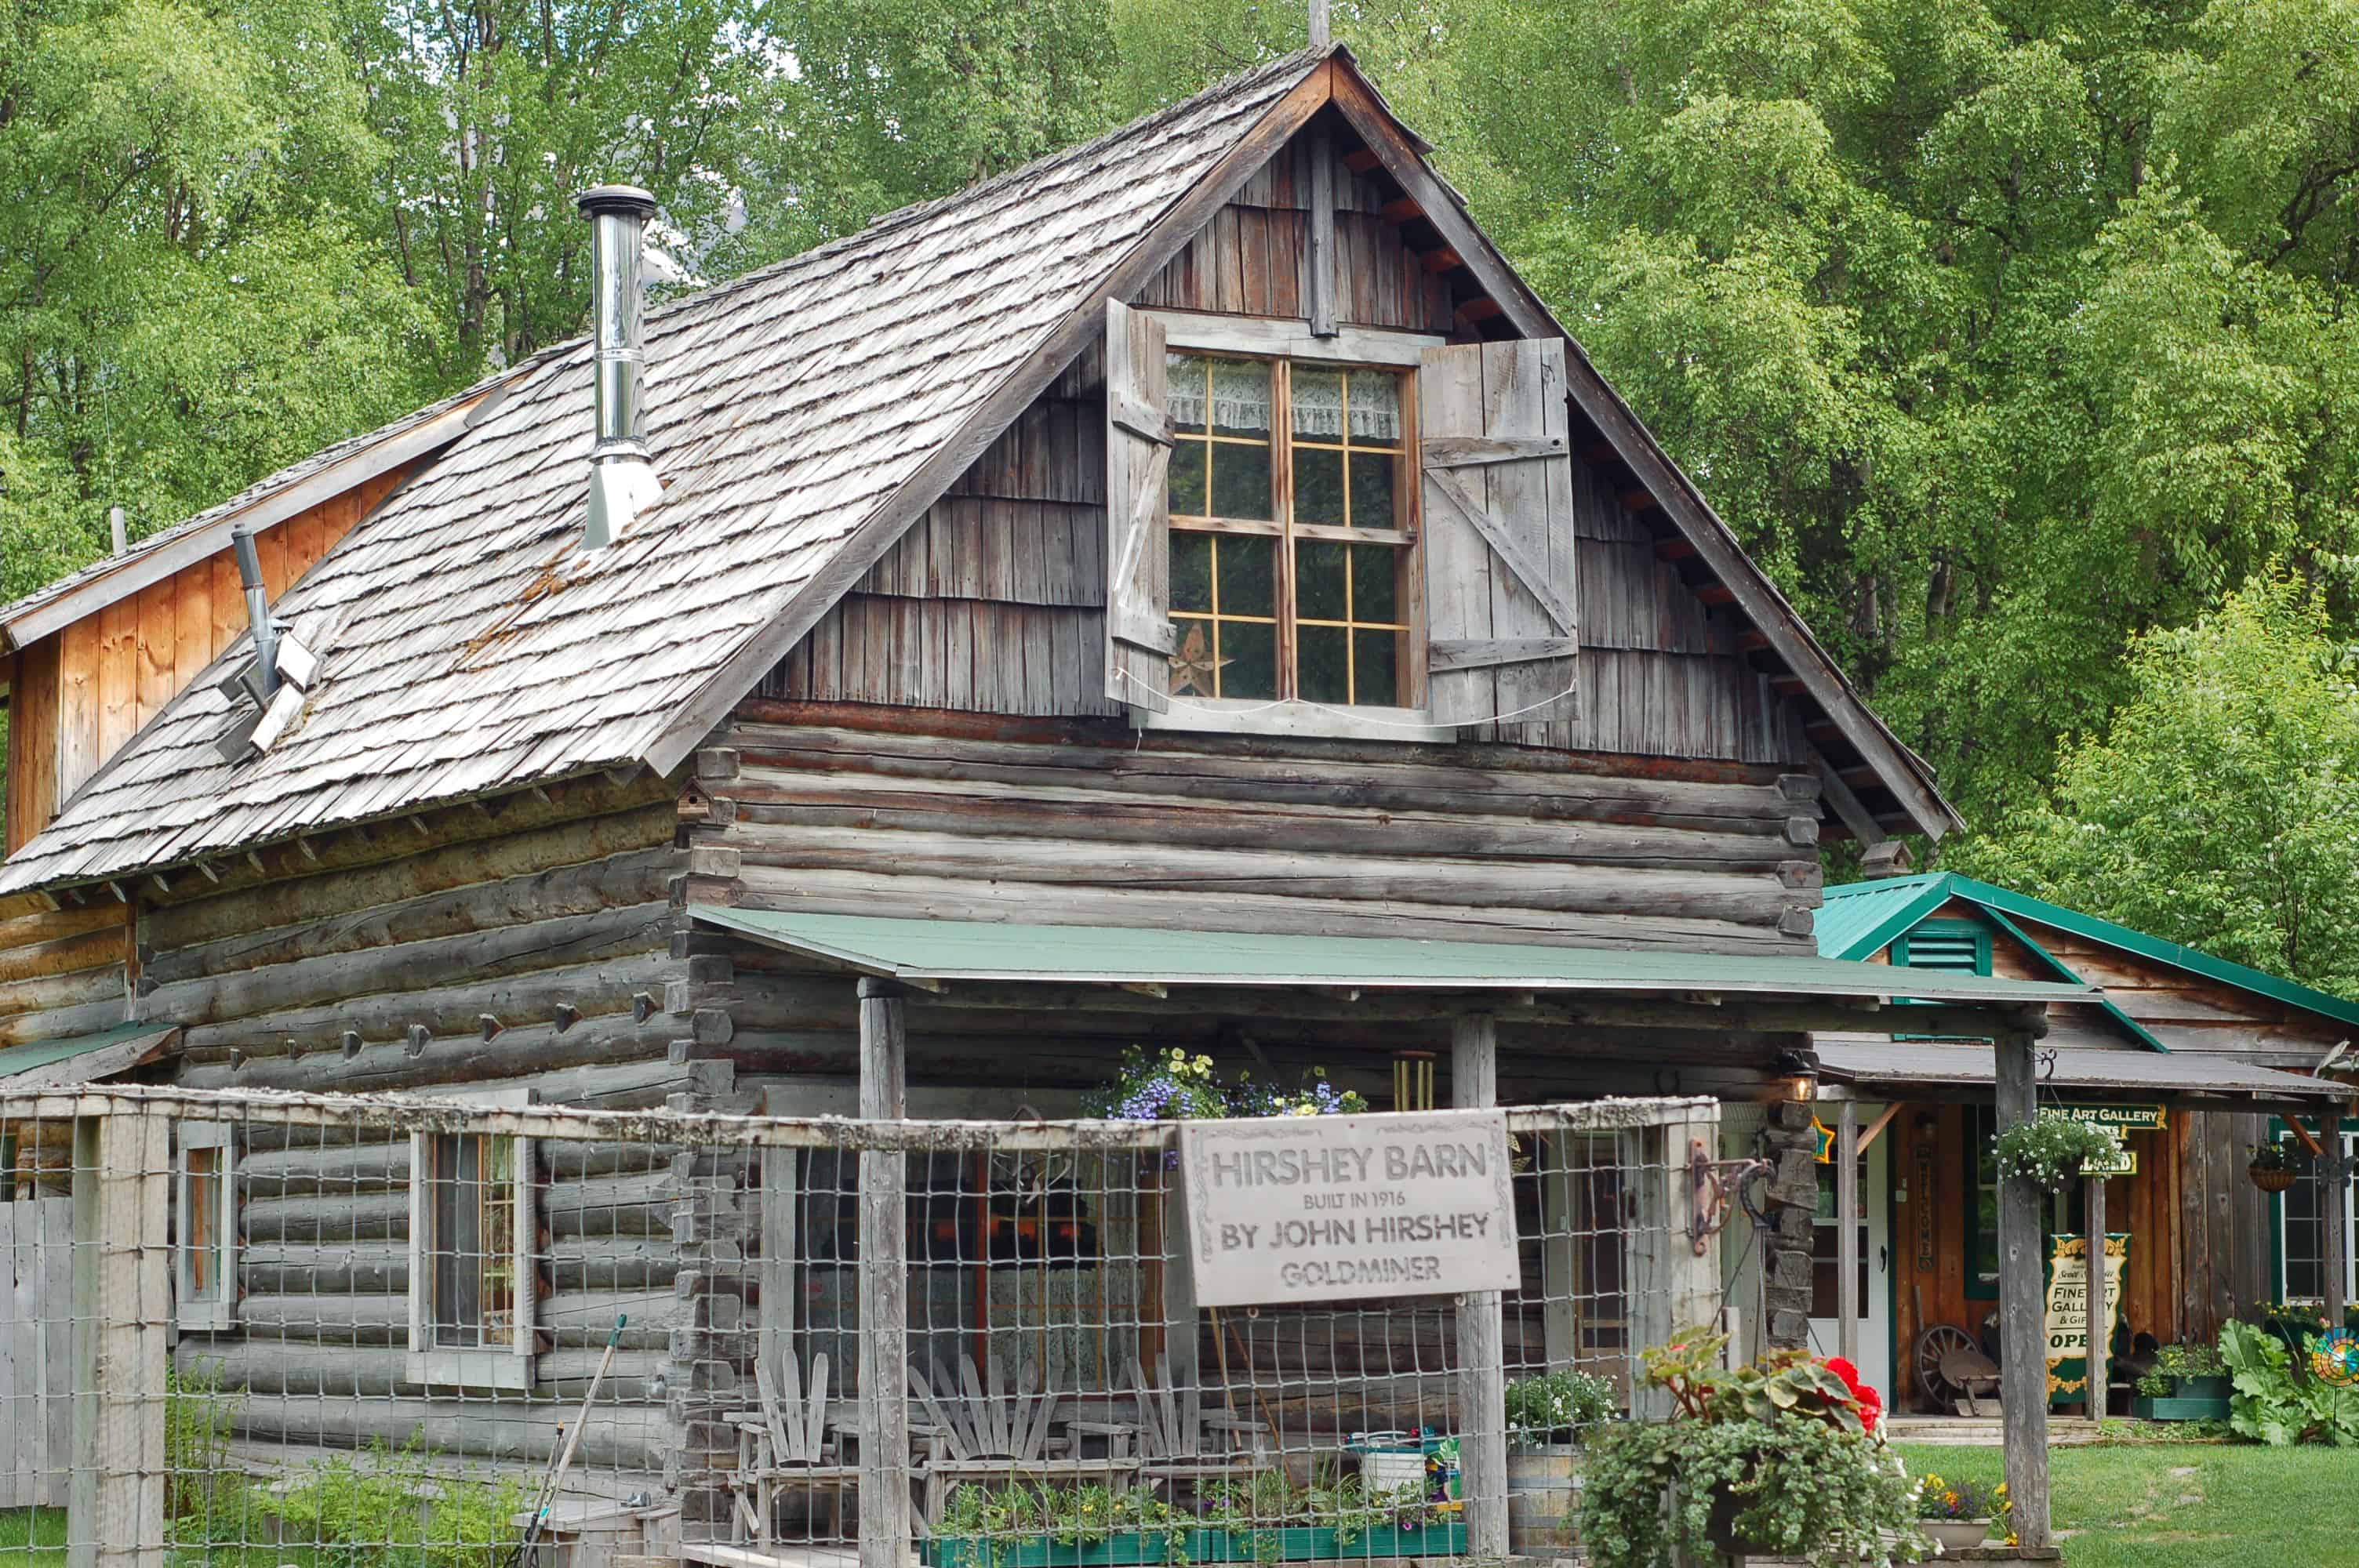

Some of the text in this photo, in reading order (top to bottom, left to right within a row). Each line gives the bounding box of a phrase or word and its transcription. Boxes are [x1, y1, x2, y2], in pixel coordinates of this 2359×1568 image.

[2039, 1107, 2157, 1122] FINE ART GALLERY
[1212, 1142, 1486, 1188] HIRSHEY BARN
[1304, 1191, 1405, 1210] BUILT IN 1916
[1220, 1213, 1489, 1250] BY JOHN HIRSHEY
[1281, 1256, 1441, 1288] GOLDMINER
[2053, 1287, 2087, 1299] FINE
[2052, 1301, 2113, 1312] GALLY
[2059, 1316, 2067, 1324] &
[2050, 1334, 2088, 1348] OPE
